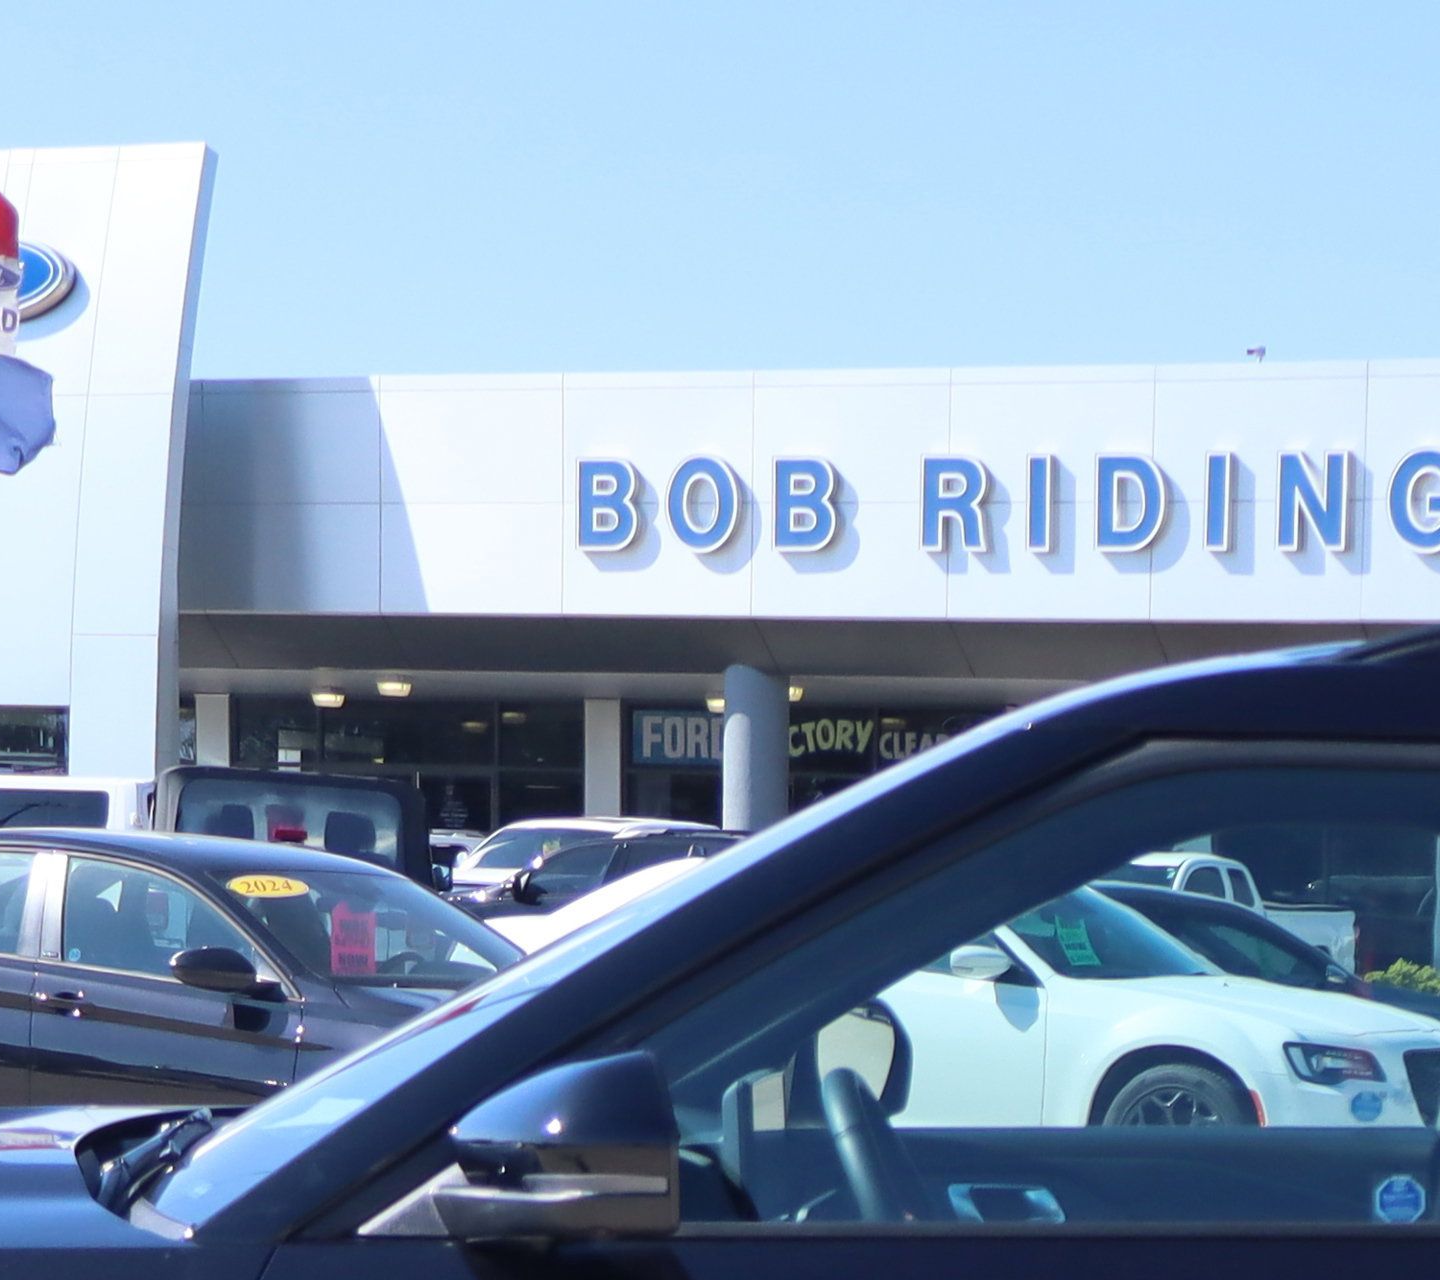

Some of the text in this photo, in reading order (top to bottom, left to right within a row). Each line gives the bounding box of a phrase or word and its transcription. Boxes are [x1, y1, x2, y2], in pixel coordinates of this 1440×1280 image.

[575, 454, 837, 554] BOB
[789, 718, 873, 756] CTORY
[240, 880, 293, 893] 2024
